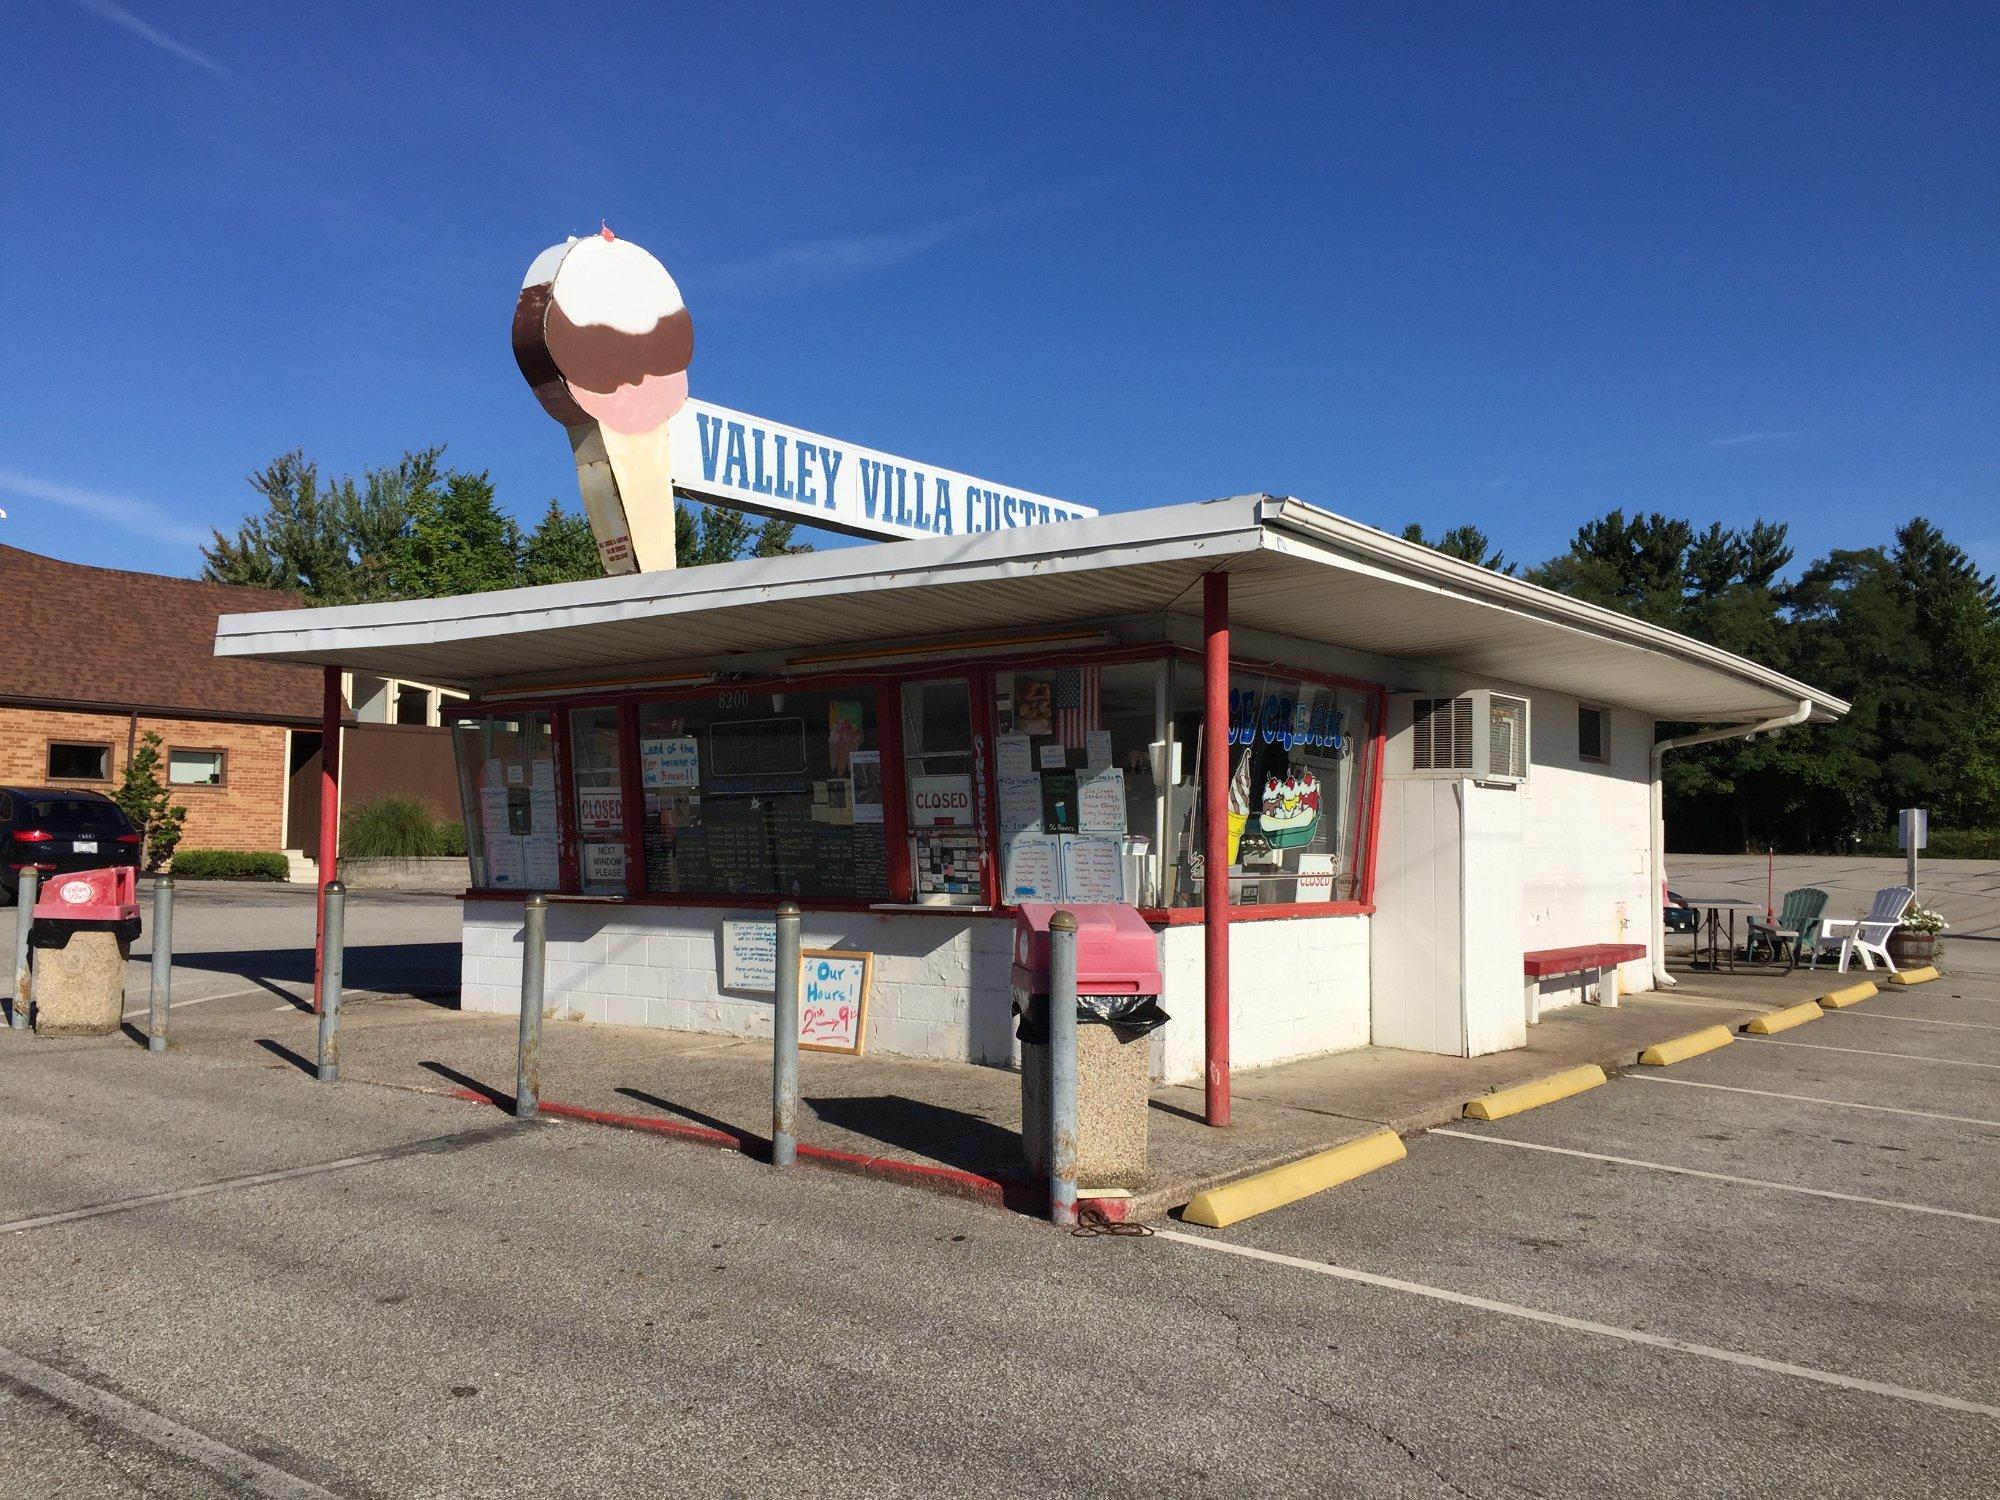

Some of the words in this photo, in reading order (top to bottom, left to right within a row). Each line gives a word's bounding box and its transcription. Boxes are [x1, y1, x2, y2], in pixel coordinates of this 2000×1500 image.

[696, 412, 842, 510] VALLEY
[859, 457, 953, 536] VILLA
[966, 485, 1084, 534] CUST
[719, 689, 749, 709] 8200
[667, 742, 677, 754] of
[915, 792, 968, 809] CLOSED
[582, 799, 622, 820] CLOSED
[597, 845, 616, 856] NEXT
[593, 857, 622, 867] WINDOW
[594, 868, 622, 878] PLEASE
[1299, 871, 1331, 887] CLOSED
[817, 961, 846, 981] Our
[807, 981, 853, 1003] Hours!
